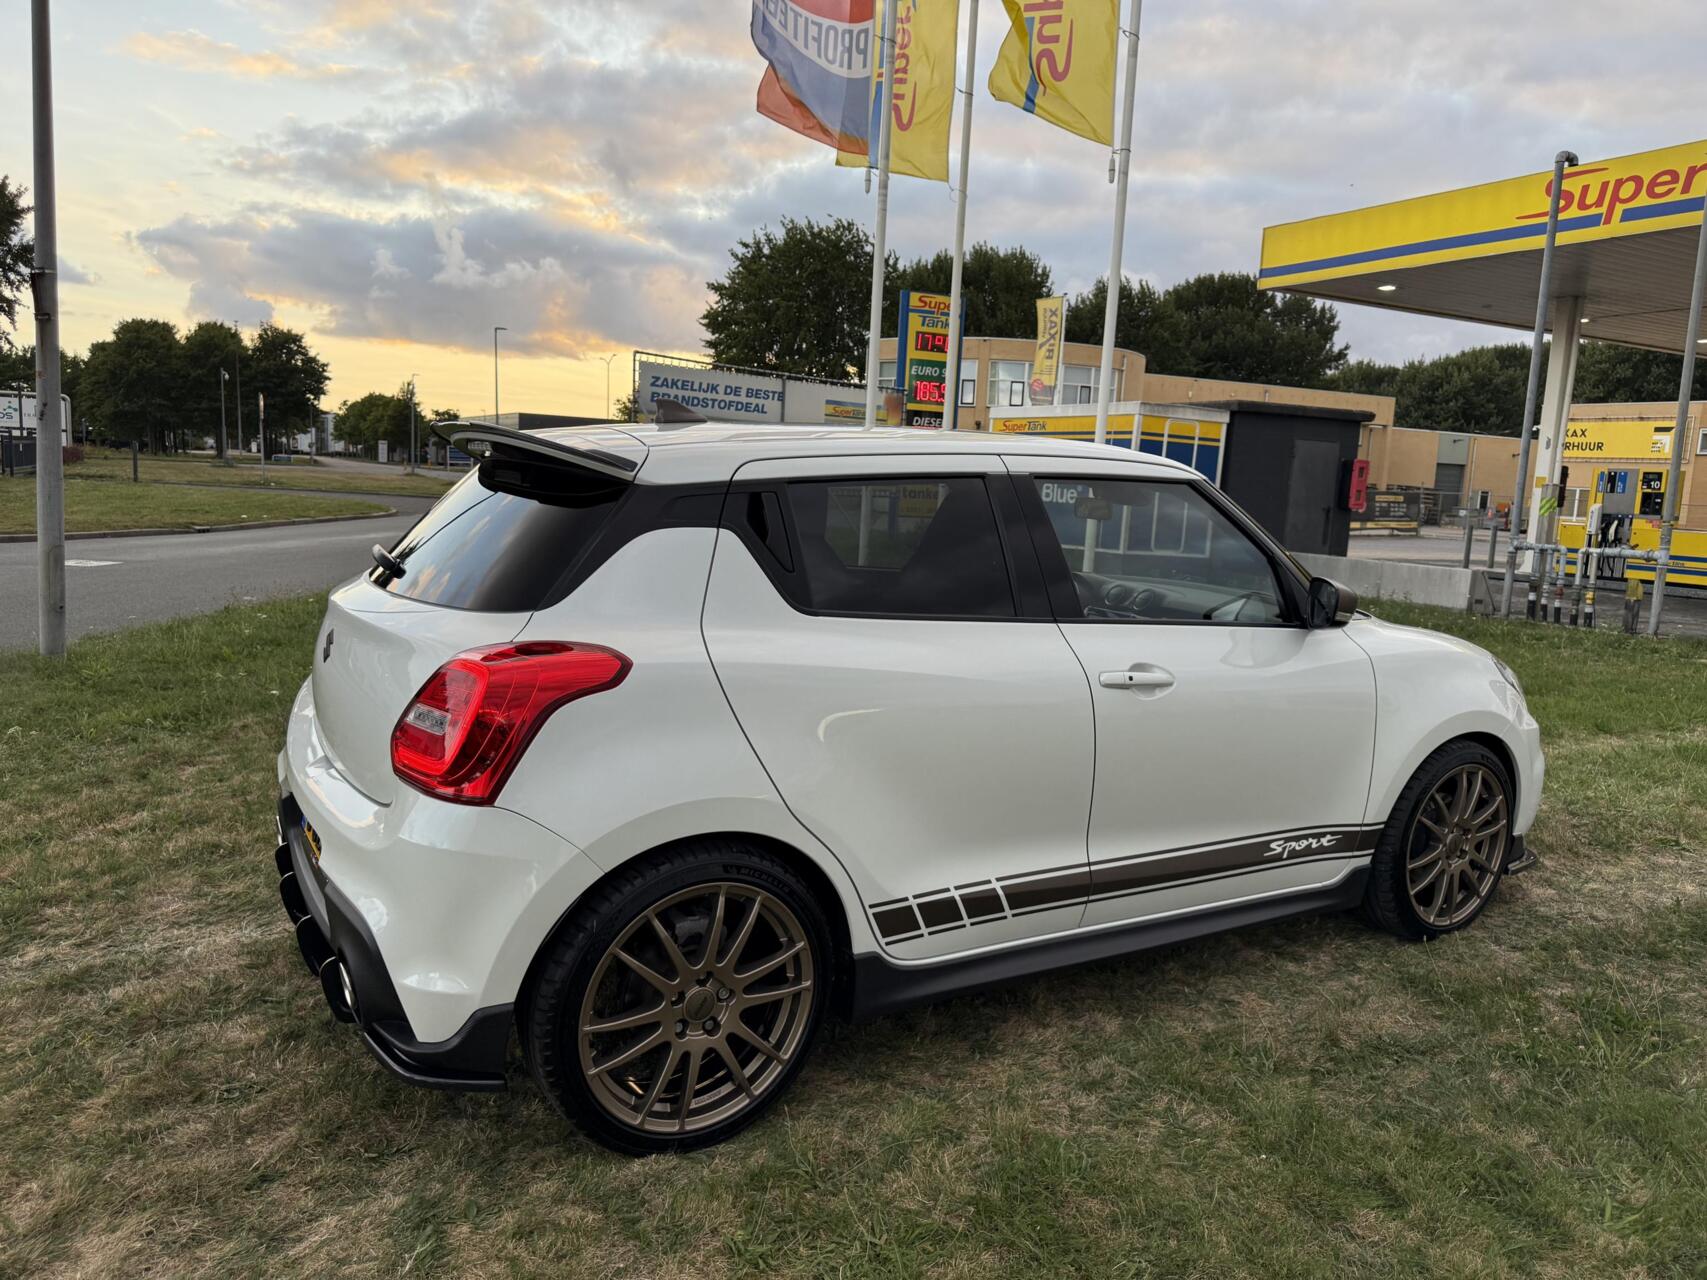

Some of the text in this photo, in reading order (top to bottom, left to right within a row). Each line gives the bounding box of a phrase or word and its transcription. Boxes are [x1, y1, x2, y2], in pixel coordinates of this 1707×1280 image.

[1515, 163, 1707, 225] Super
[911, 365, 939, 376] EURO
[650, 376, 783, 402] ZAKELIJK DE BESTE
[913, 416, 943, 428] DIESE
[1041, 483, 1078, 504] Blue
[1650, 481, 1660, 489] 10
[1264, 834, 1343, 859] Sport
